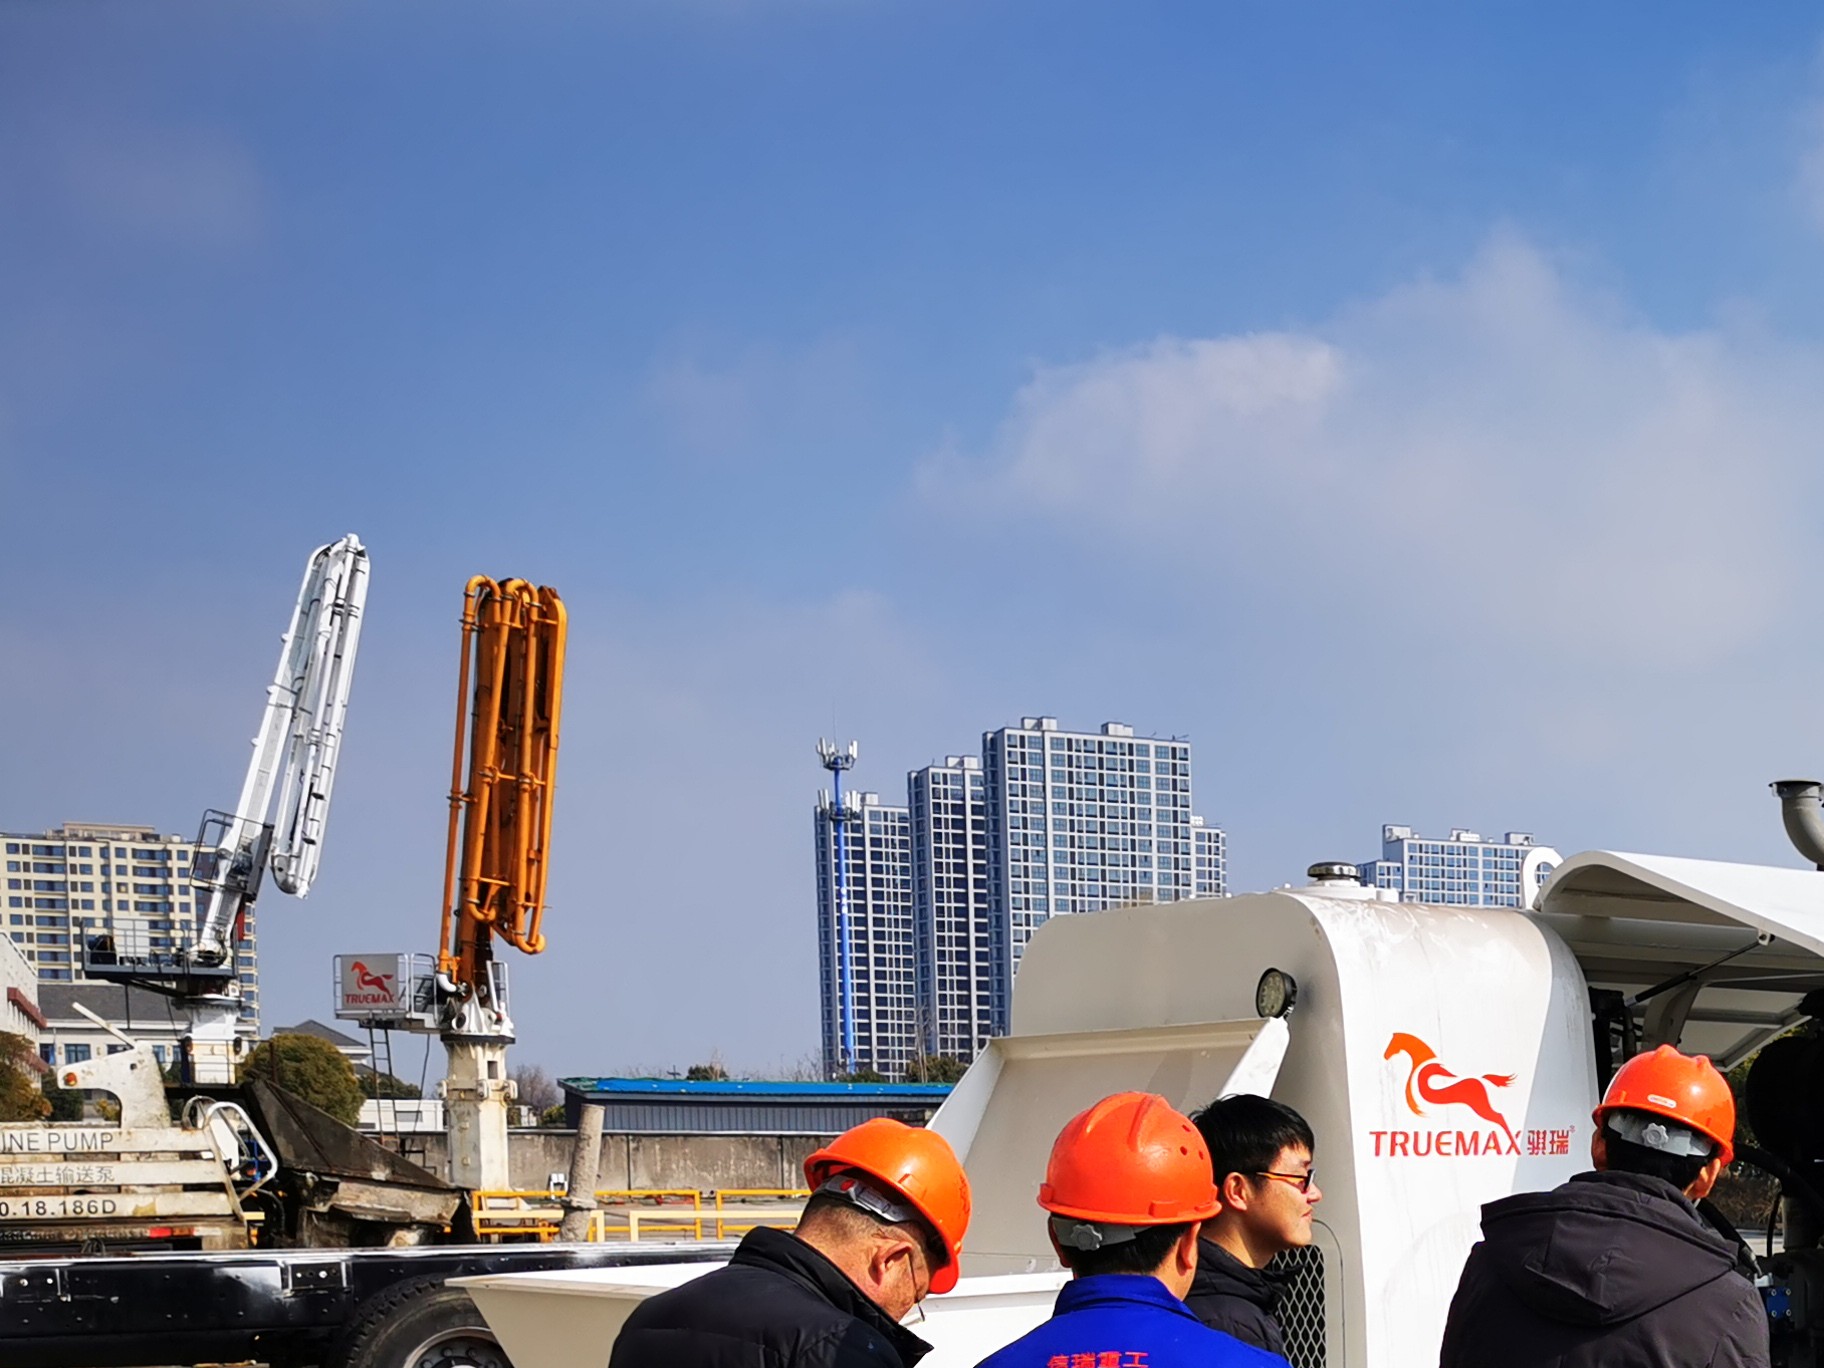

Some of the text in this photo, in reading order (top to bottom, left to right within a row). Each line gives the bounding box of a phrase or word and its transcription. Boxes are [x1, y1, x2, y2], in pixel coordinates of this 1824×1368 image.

[345, 993, 395, 1004] TRUEMAX
[48, 1132, 114, 1151] PUMP
[1369, 1130, 1522, 1156] TRUEMAX
